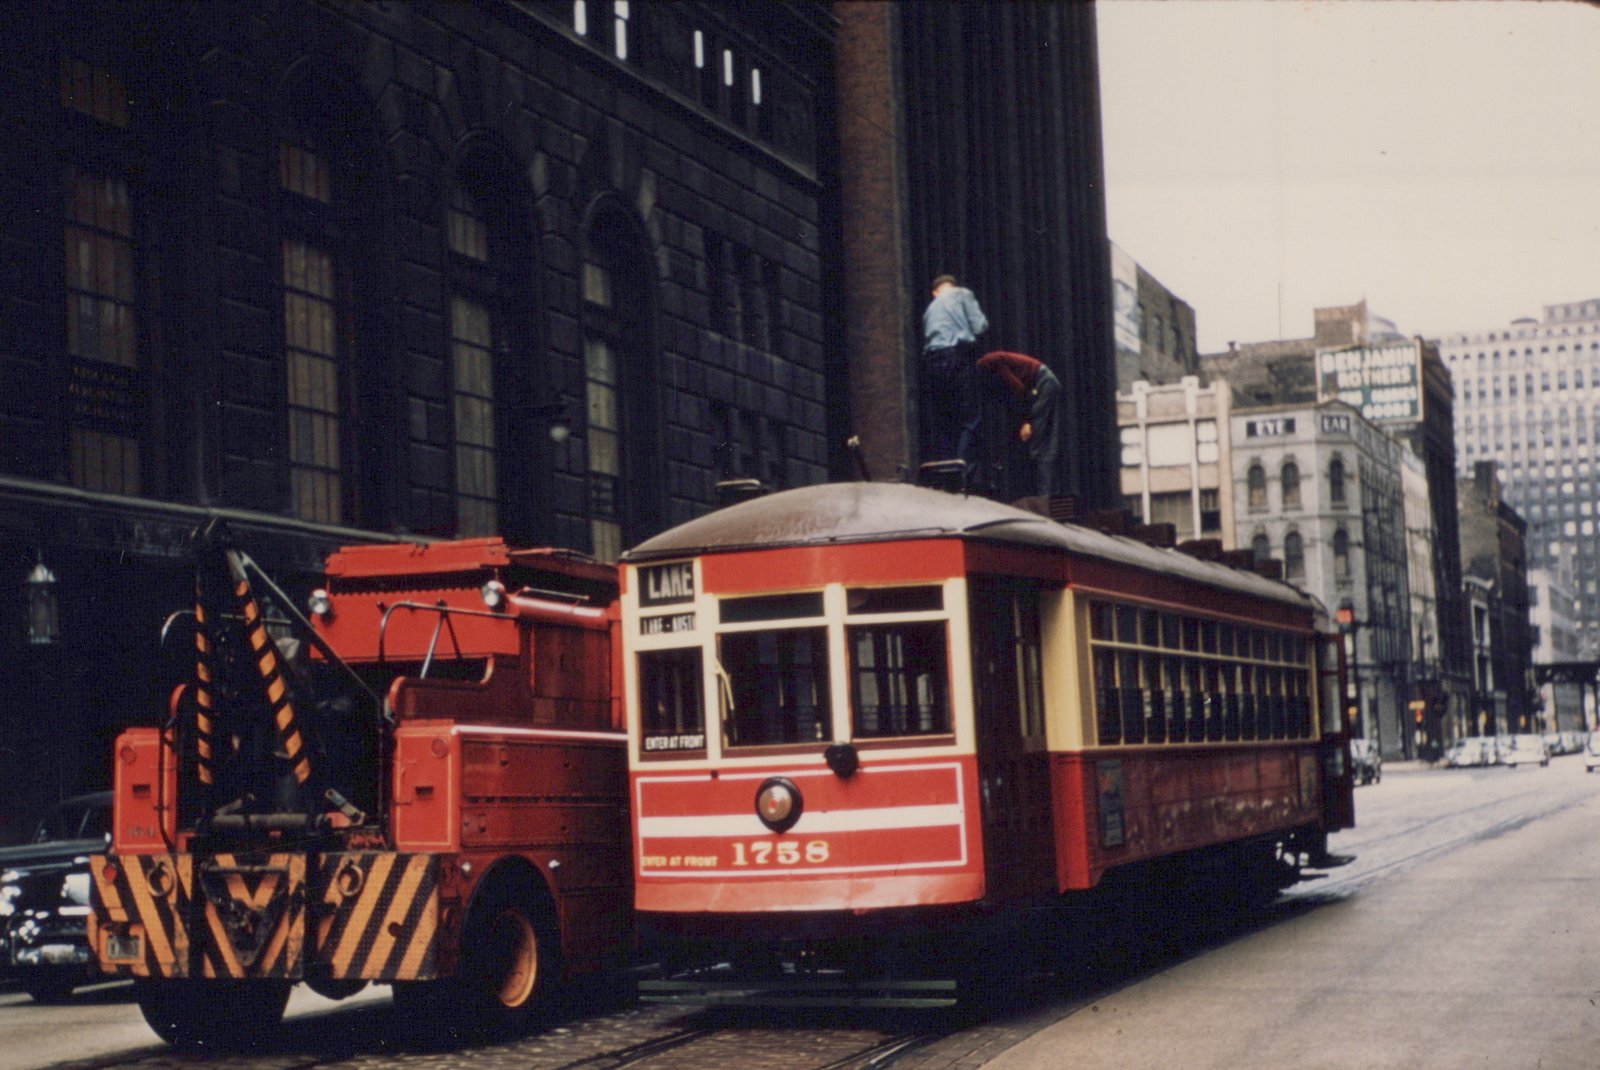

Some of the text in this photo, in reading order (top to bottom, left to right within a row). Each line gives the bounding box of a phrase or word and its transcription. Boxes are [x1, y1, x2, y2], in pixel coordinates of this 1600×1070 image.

[1321, 347, 1415, 373] BENJAMIN
[1336, 366, 1411, 389] ROTHERS
[648, 565, 693, 599] LAKE
[643, 617, 663, 635] LAKE
[645, 734, 704, 750] ENTER AT FRONT
[643, 855, 718, 867] ENTER AT FRONT
[732, 840, 830, 866] 1758
